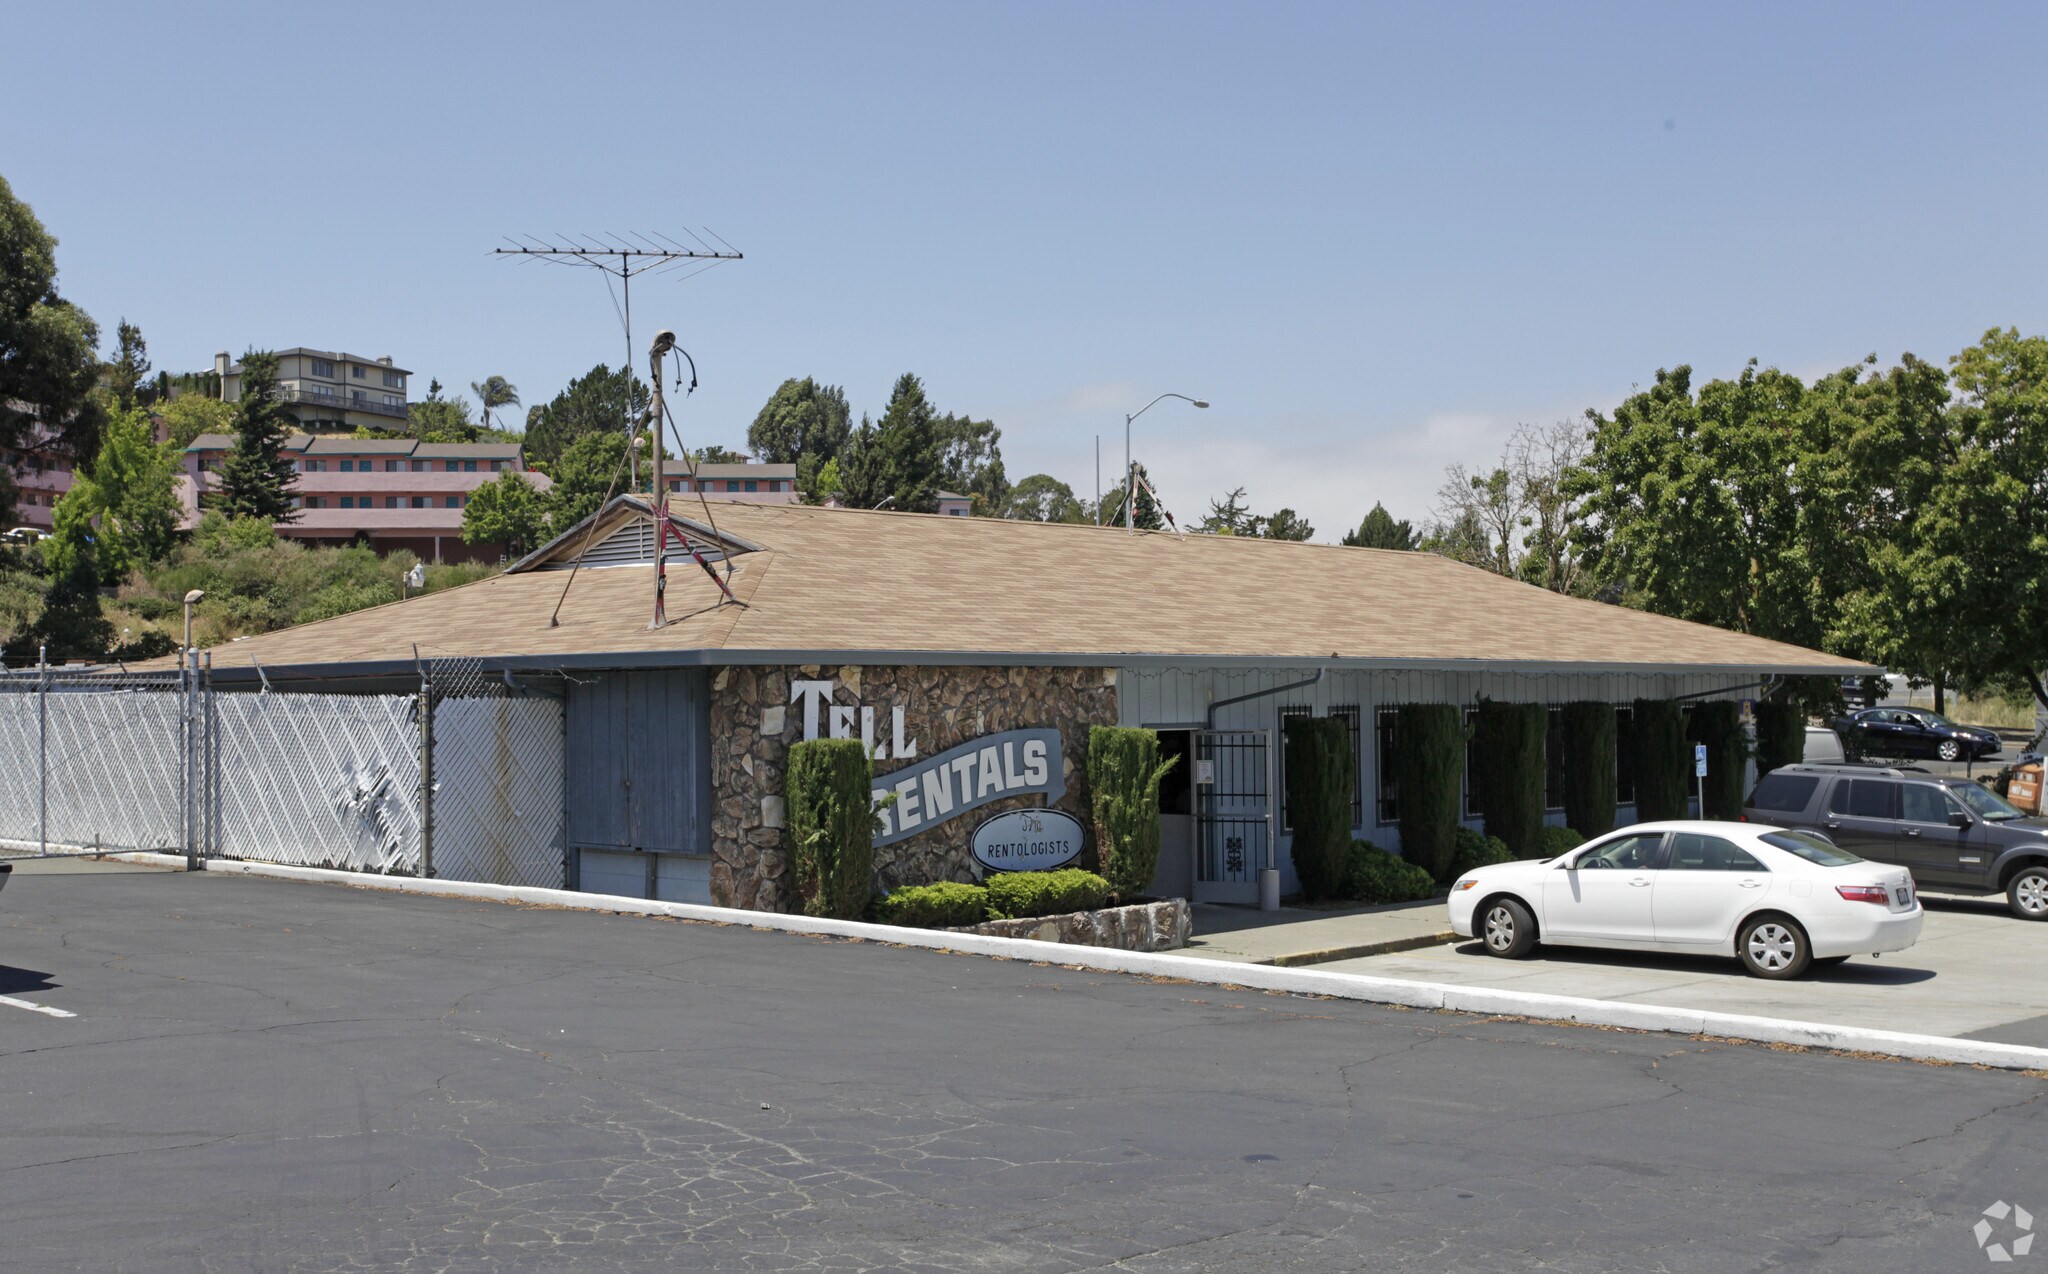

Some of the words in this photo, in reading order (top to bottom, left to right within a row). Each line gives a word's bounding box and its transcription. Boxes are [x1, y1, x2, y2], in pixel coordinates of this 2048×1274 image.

[791, 680, 917, 760] TELL
[871, 739, 1048, 840] RENTALS
[987, 840, 1069, 858] RENTOLOGISTS
